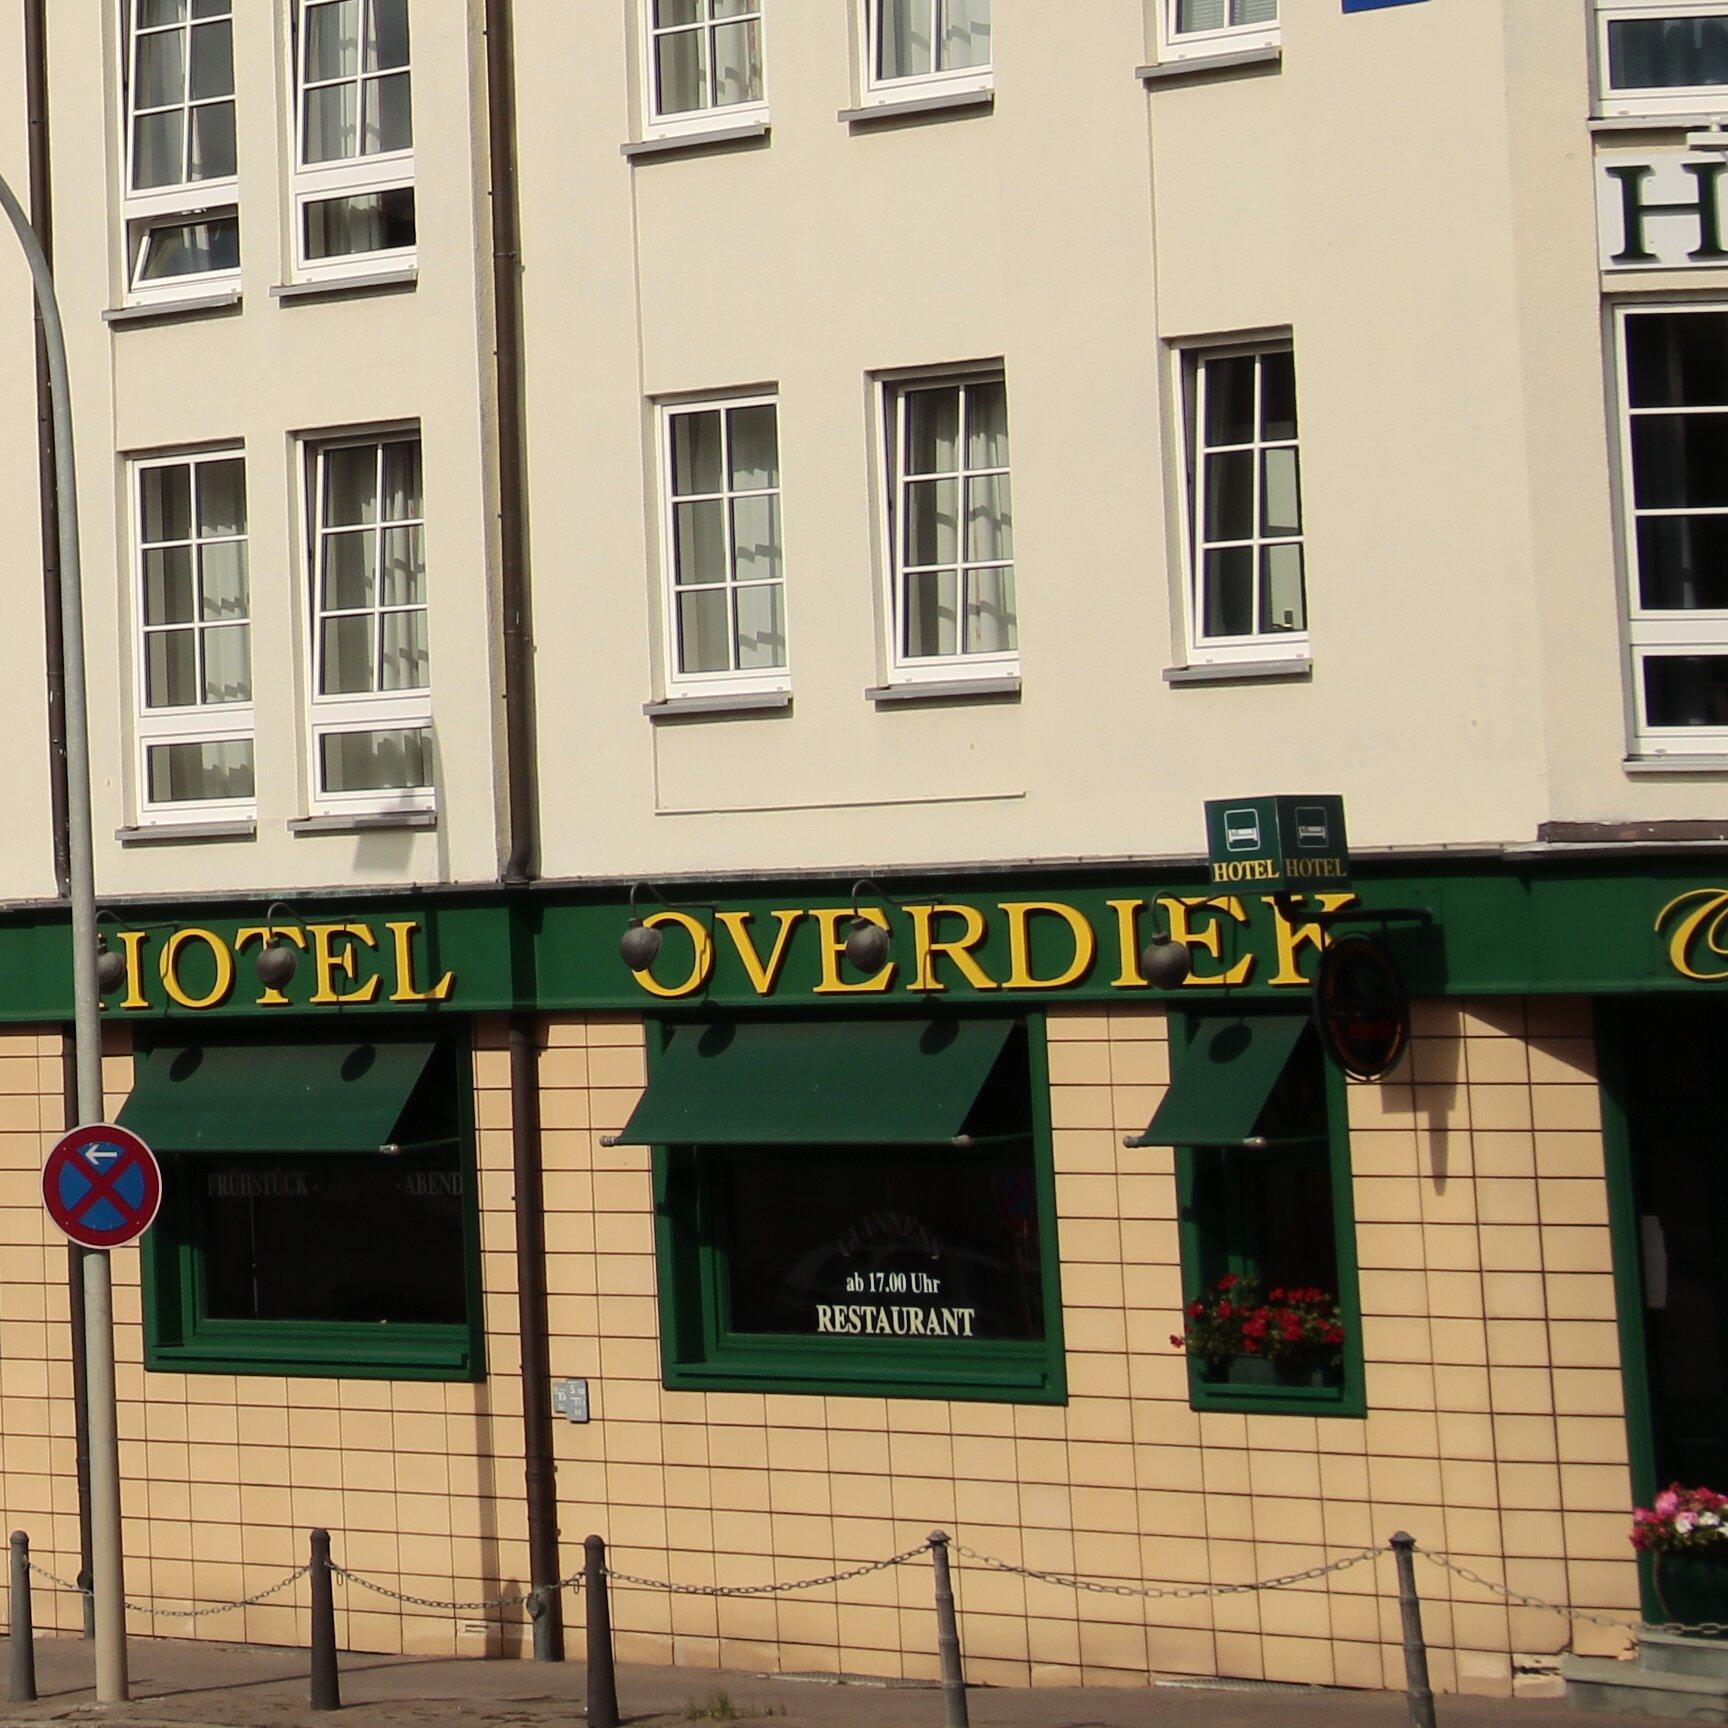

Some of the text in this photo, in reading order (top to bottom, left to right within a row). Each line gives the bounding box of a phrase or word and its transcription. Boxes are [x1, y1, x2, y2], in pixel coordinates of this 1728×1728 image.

[1213, 859, 1279, 882] HOTEL
[1286, 858, 1347, 877] HOTEL
[631, 892, 1355, 997] OVERDIEK
[846, 1272, 941, 1294] ab 17.00 Uhr
[816, 1304, 975, 1337] RESTAURANT
